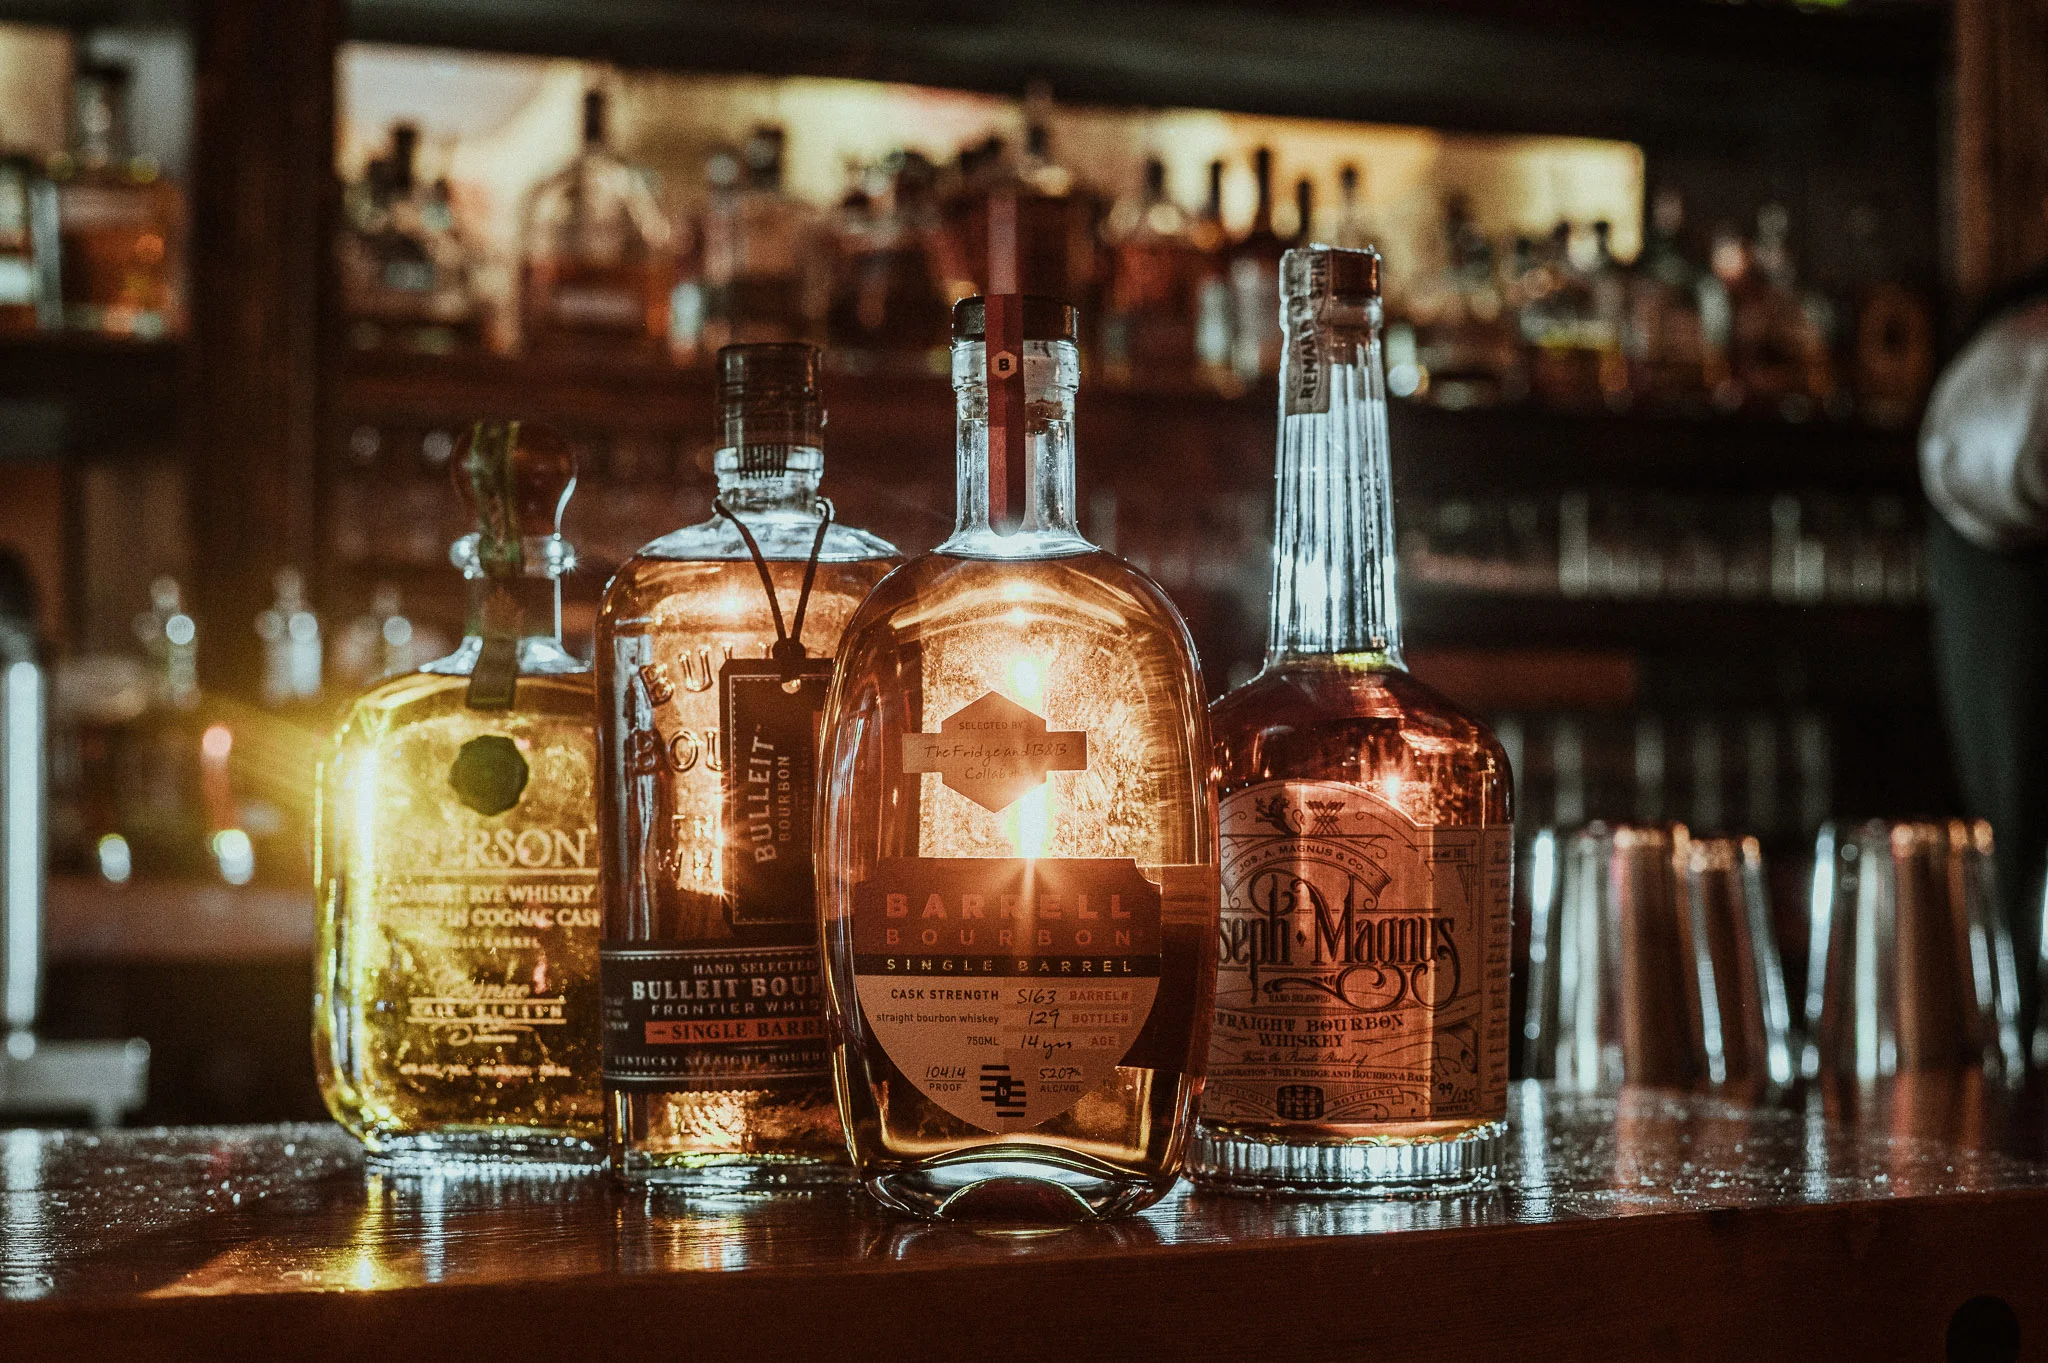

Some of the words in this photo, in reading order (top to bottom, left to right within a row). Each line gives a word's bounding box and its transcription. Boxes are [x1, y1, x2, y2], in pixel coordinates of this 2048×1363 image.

[999, 358, 1010, 371] B
[958, 721, 1008, 730] SELECTED
[1012, 721, 1024, 730] BY
[924, 745, 950, 758] The
[952, 744, 1000, 767] Fridge
[748, 735, 778, 864] BULLEIT
[777, 755, 792, 842] BOURBON
[1239, 855, 1262, 873] JOS.
[1279, 844, 1333, 857] MAGNUS
[1336, 852, 1344, 861] &
[1348, 857, 1365, 873] CO.
[471, 884, 506, 904] RYE
[507, 884, 596, 904] WHISKEY
[886, 893, 1132, 921] BARRELL
[470, 908, 556, 928] COGNAC
[886, 929, 1131, 946] BOURBON
[1310, 874, 1458, 998] Magnus
[693, 964, 735, 976] HAND
[740, 960, 817, 974] SELECTED
[887, 958, 993, 972] SINGLE
[1017, 960, 1132, 973] BARREL
[632, 978, 740, 1001] BULLEIT
[891, 989, 924, 1000] CASK
[930, 990, 999, 1000] STRENGTH
[1069, 991, 1128, 1000] BARREL#
[652, 1001, 755, 1016] FRONTIER
[876, 1014, 914, 1024] straight
[916, 1013, 957, 1023] bourbon
[960, 1014, 1000, 1025] whiskey
[1028, 1008, 1060, 1029] 129
[1072, 1014, 1128, 1024] BOTTLE#
[1306, 1013, 1405, 1033] BOURBON
[672, 1022, 748, 1040] SINGLE
[966, 1036, 1000, 1046] 750ML
[1020, 1034, 1039, 1049] 14
[1090, 1036, 1116, 1046] AGE
[1259, 1033, 1345, 1048] WHISKEY
[1293, 1068, 1330, 1078] FRIDGE
[1332, 1070, 1351, 1078] AND
[1352, 1070, 1398, 1080] BOURBON
[929, 1083, 962, 1092] PROOF
[1040, 1084, 1082, 1094] ALC/VOL
